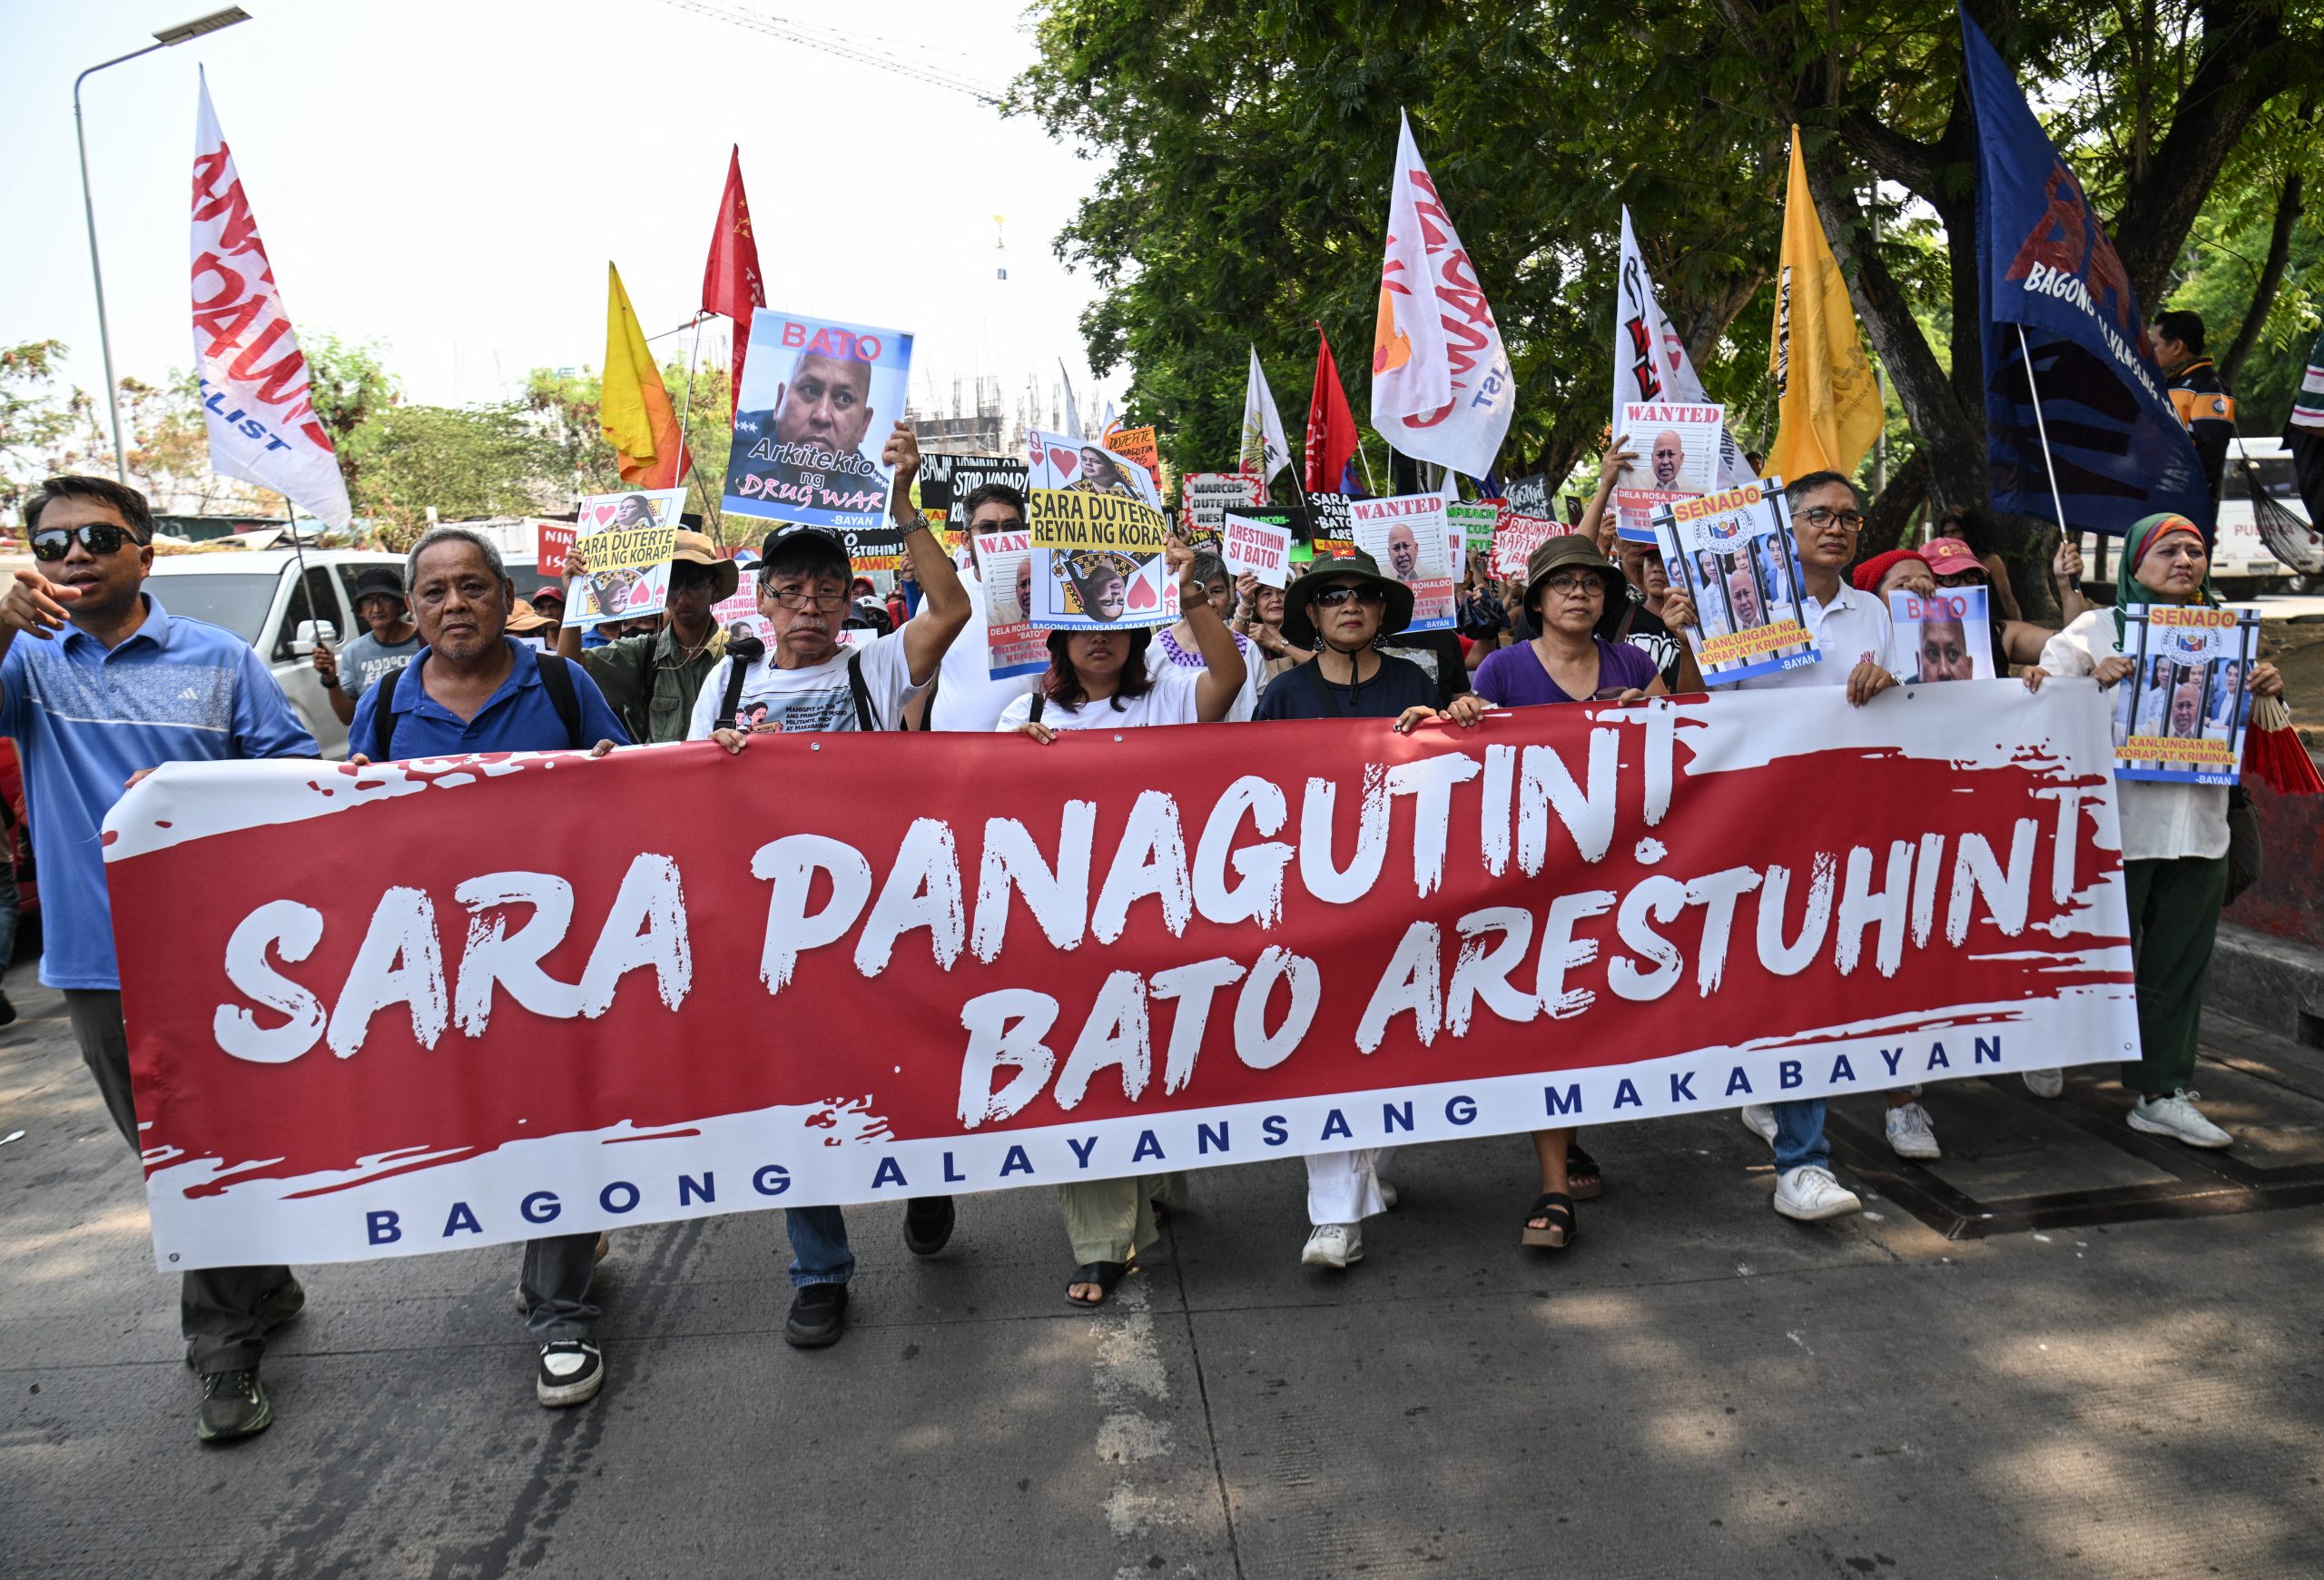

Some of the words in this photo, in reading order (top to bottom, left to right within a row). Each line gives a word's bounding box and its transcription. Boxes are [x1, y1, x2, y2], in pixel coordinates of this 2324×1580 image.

[2023, 261, 2095, 318] BAGONG
[782, 321, 882, 361] BATO
[1627, 405, 1719, 423] WANTED
[1029, 431, 1043, 450] Q
[1108, 430, 1152, 449] DUTERTE
[748, 438, 876, 477] Arkitekto
[800, 470, 825, 489] ng
[1194, 483, 1248, 494] MARCOS-
[740, 473, 813, 511] DRUG
[820, 489, 885, 513] WAR
[1619, 489, 1640, 499] DELA
[1641, 491, 1669, 501] ROSA,
[1031, 493, 1083, 519] SARA
[1088, 497, 1167, 534] DUTERTE
[1354, 497, 1443, 521] WANTED
[1675, 487, 1760, 521] SENADO
[830, 515, 873, 526] -BAYAN
[545, 529, 574, 544] NIN
[575, 536, 608, 557] SARA
[611, 528, 675, 551] DUTERTE
[1035, 520, 1088, 543] REYNA
[1092, 521, 1115, 544] NG
[1119, 523, 1163, 546] KORA
[1228, 523, 1285, 552] ARESTUHIN
[979, 534, 1031, 554] WAN
[1708, 545, 1735, 553] OFFICIAL
[1734, 538, 1750, 551] SEAL
[586, 552, 608, 569] YNA
[611, 550, 627, 566] NG
[629, 544, 672, 564] KORAP!
[1229, 541, 1241, 560] SI
[1244, 544, 1280, 570] BATO!
[1412, 579, 1452, 590] RONALDO
[1906, 596, 1968, 619] BATO
[1071, 622, 1124, 631] ALYANSANG
[1125, 617, 1178, 629] MAKABAYAN
[1423, 619, 1450, 628] -BAYAN
[2151, 609, 2237, 628] SENADO
[990, 626, 1010, 637] DELA
[1704, 625, 1777, 652] KANLUNGAN
[1778, 621, 1797, 632] NG
[1738, 644, 1752, 657] AT
[1756, 630, 1812, 651] KRIMINAL
[1781, 656, 1816, 670] -BAYAN
[2129, 737, 2205, 750] KANLUNGAN
[2207, 741, 2226, 751] NG
[2115, 747, 2157, 759] KORAP
[2159, 749, 2176, 760] AT
[2178, 750, 2237, 764] KRIMINAL
[2195, 775, 2231, 785] -BAYAN
[213, 851, 694, 1064] SARA
[750, 701, 1678, 995] PANAGUTIN!
[958, 944, 1321, 1130] BATO
[1354, 788, 2080, 1054] ARESTUHIN!
[366, 1164, 791, 1245] BAGONG
[871, 1095, 1479, 1189] ALAYANSANG
[1544, 1035, 2002, 1116] MAKABAYAN
